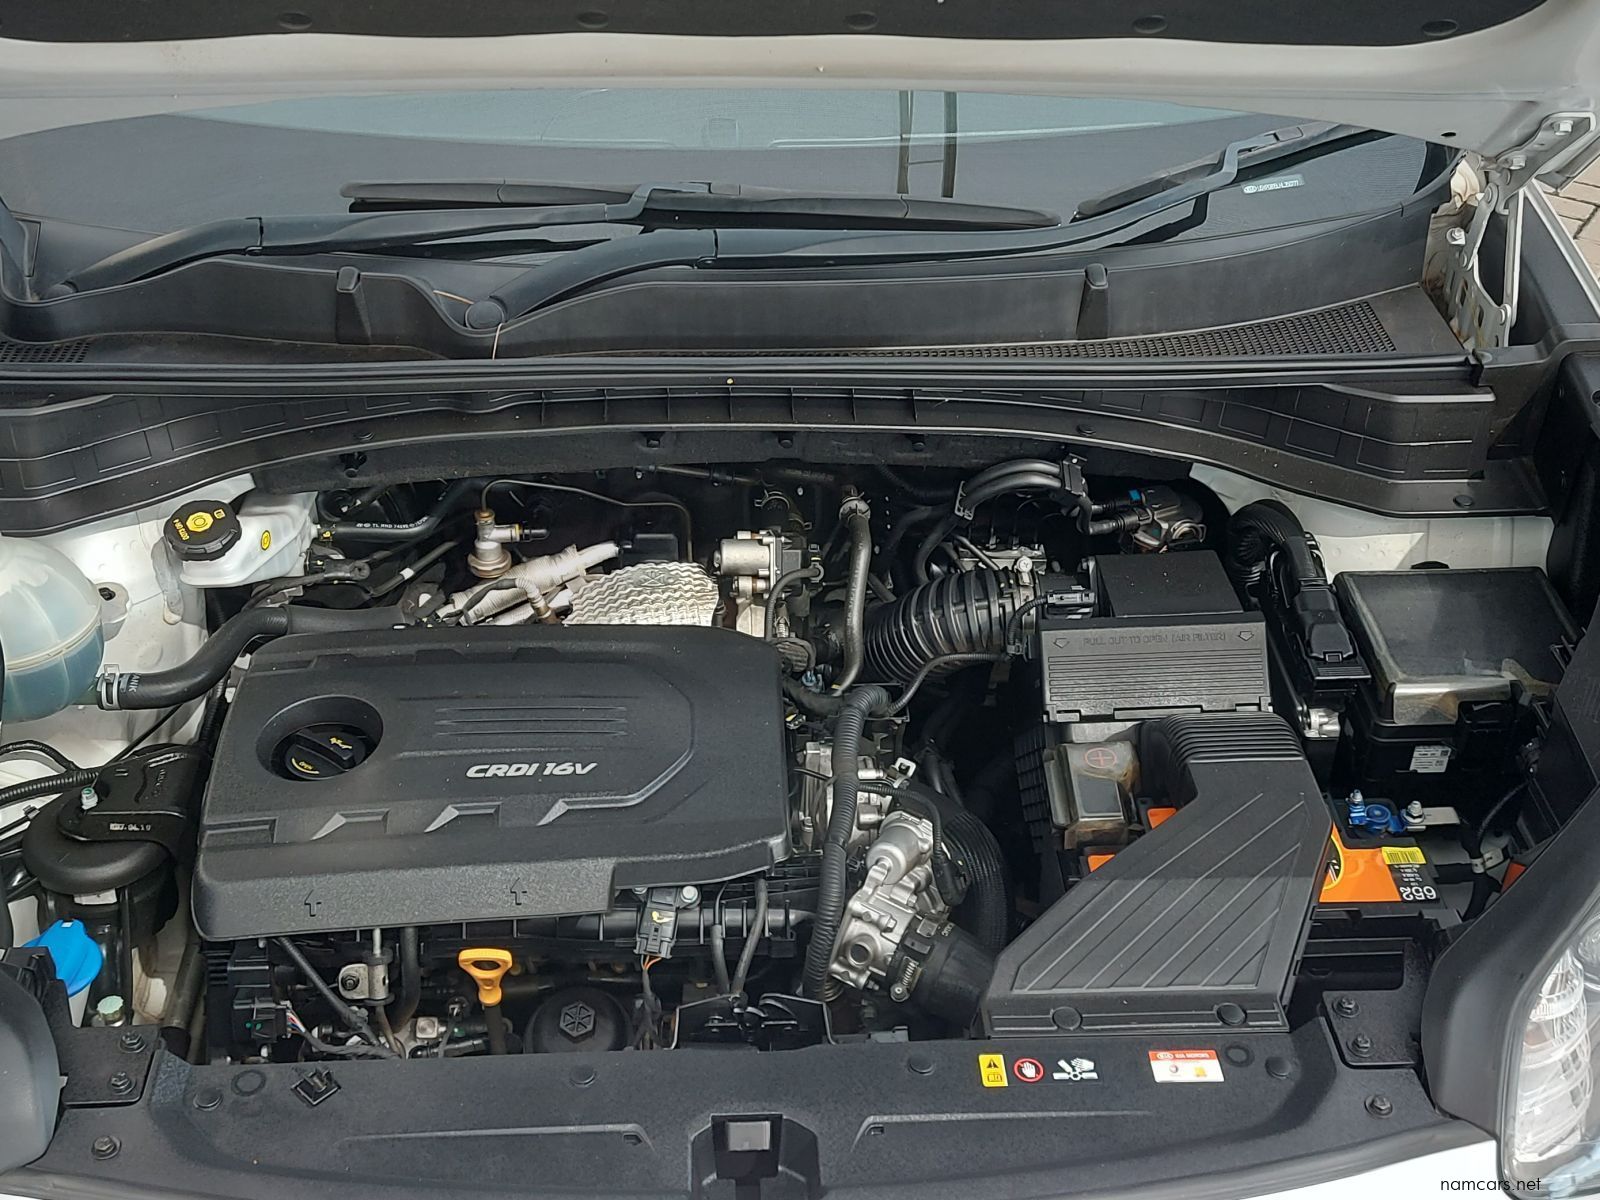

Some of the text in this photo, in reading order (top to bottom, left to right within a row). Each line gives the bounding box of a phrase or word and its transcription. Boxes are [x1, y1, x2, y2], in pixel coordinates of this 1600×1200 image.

[1083, 636, 1106, 646] PULL
[1108, 636, 1127, 645] OUT
[1127, 636, 1141, 644] TO
[1142, 634, 1168, 643] OPEN
[466, 762, 598, 778] CRDI 16V
[1400, 886, 1437, 901] 652
